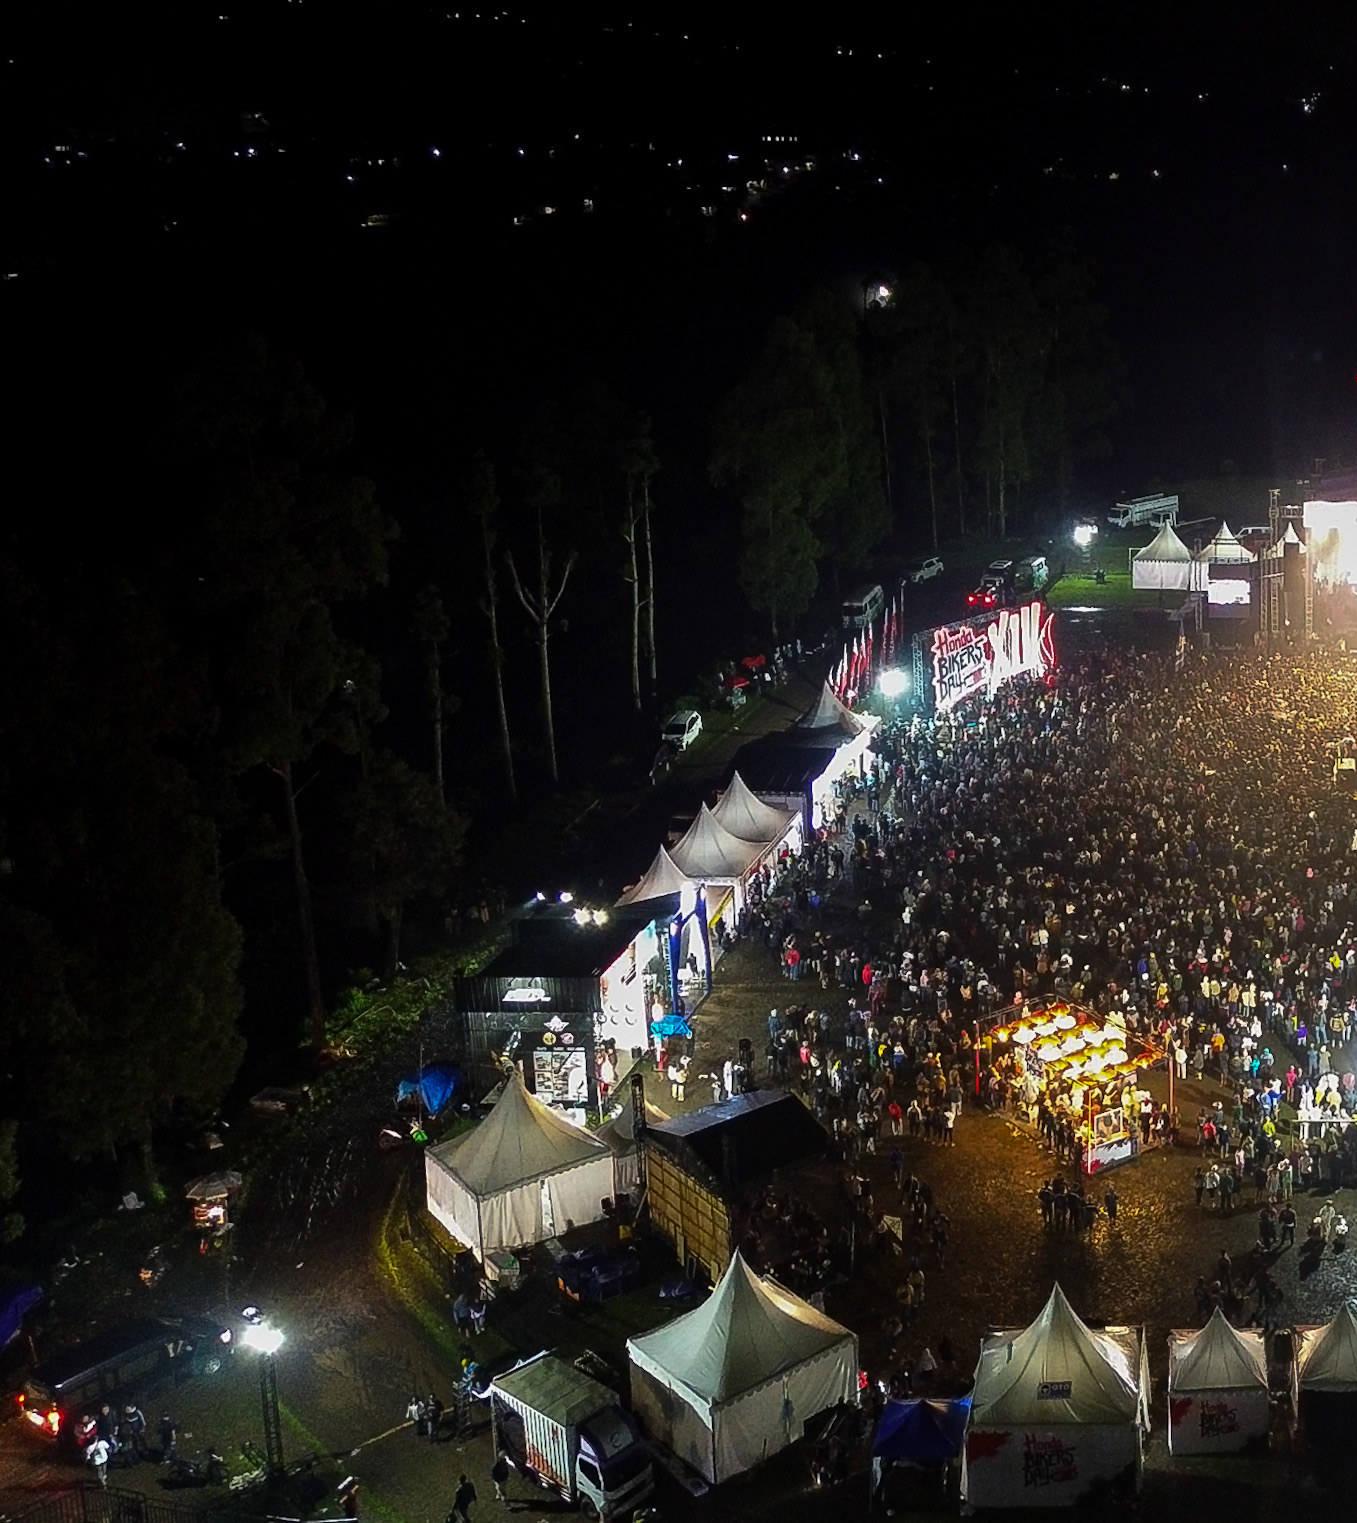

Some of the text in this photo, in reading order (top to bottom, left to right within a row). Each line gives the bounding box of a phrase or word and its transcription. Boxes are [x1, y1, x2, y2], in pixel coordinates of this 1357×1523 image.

[937, 630, 973, 656] Honda
[938, 638, 985, 678] BIKERS
[937, 674, 964, 703] DAY
[1200, 1399, 1229, 1414] Honda
[1023, 1433, 1063, 1451] Honda
[1023, 1446, 1076, 1469] BIKERS
[1022, 1464, 1051, 1487] DAY
